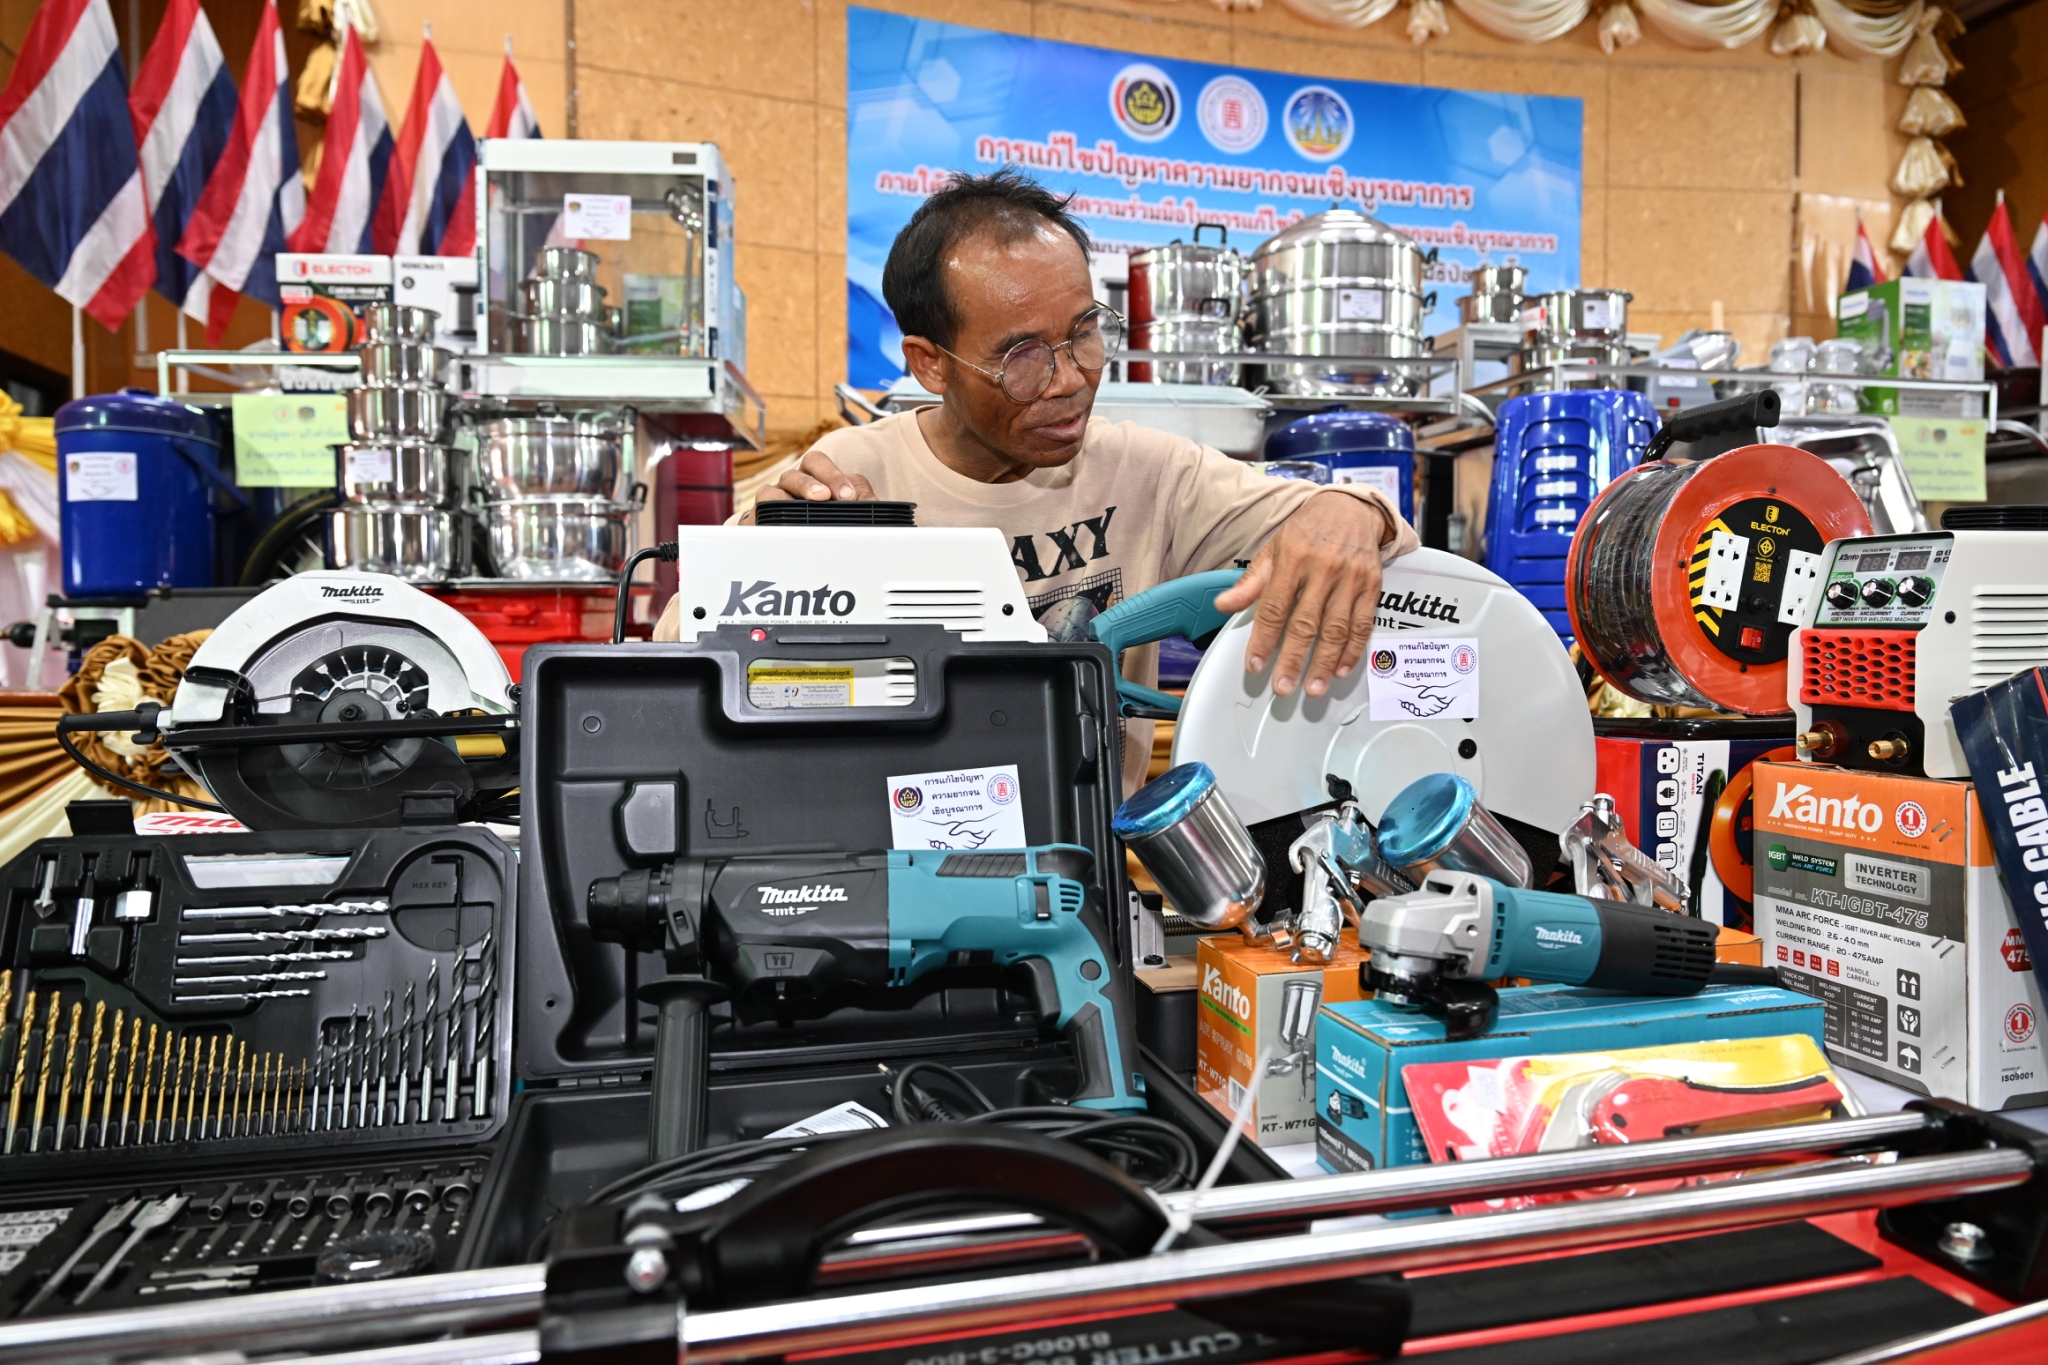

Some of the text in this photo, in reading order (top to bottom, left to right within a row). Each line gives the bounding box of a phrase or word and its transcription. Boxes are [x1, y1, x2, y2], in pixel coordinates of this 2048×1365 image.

[979, 134, 1472, 211] การแก้ไขปัญหาความยากจนเชิงบูรณาการ
[1751, 521, 1788, 536] ELECTON
[1839, 553, 1859, 561] Kanto
[320, 585, 384, 597] makita
[719, 580, 856, 617] Kanto
[1399, 642, 1450, 652] การแก้ไขปัญหา
[1403, 670, 1447, 681] เชิงบูรณาการ
[924, 773, 985, 786] การแก้ไขปัญหา
[1696, 752, 1705, 795] TITAN
[931, 789, 981, 800] ความยากจน
[931, 804, 984, 817] เชิงบูรณาการ
[1768, 781, 1883, 833] Kanto
[1905, 809, 1914, 825] 1
[1997, 760, 2048, 873] CABLE
[1768, 850, 1786, 861] IGBT
[1792, 853, 1835, 868] WELD SYSTEM
[1803, 863, 1814, 871] ARC
[1816, 865, 1834, 874] FORCE
[1855, 862, 1918, 884] INVERTER
[431, 881, 448, 889] KEY
[1855, 875, 1918, 895] TECHNOLOGY
[757, 885, 848, 904] makita
[775, 906, 795, 916] mt
[1811, 887, 1929, 929] KT-IGBT-475
[1775, 905, 1921, 948] MMA ARC FORCE IGBT INVER ARC WELDER
[1775, 918, 1806, 933] WELDING
[1806, 925, 1822, 937] ROD
[1857, 940, 1870, 949] mm
[1535, 926, 1583, 945] makita
[1775, 930, 1884, 966] CURRENT RANGE 20 475AMP
[1784, 971, 1797, 980] THICK
[1846, 965, 1870, 977] HANDLE
[1781, 978, 1810, 991] TEEL RANGE
[1818, 981, 1841, 993] WELDING
[1846, 972, 1880, 988] CAREFULLY
[1202, 963, 1250, 1021] Kanto
[1824, 990, 1835, 999] ROD
[1853, 992, 1878, 1004] CURRENT
[1856, 1000, 1875, 1012] RANGE
[2014, 1012, 2022, 1028] 1
[1870, 1027, 1882, 1035] AMP
[1198, 1058, 1208, 1072] KT
[1210, 1066, 1227, 1089] W71G
[2002, 1072, 2034, 1082] ISO9001
[475, 1123, 485, 1131] 10
[1261, 1118, 1316, 1133] KT W71G
[1091, 1331, 1242, 1365] CUTTER
